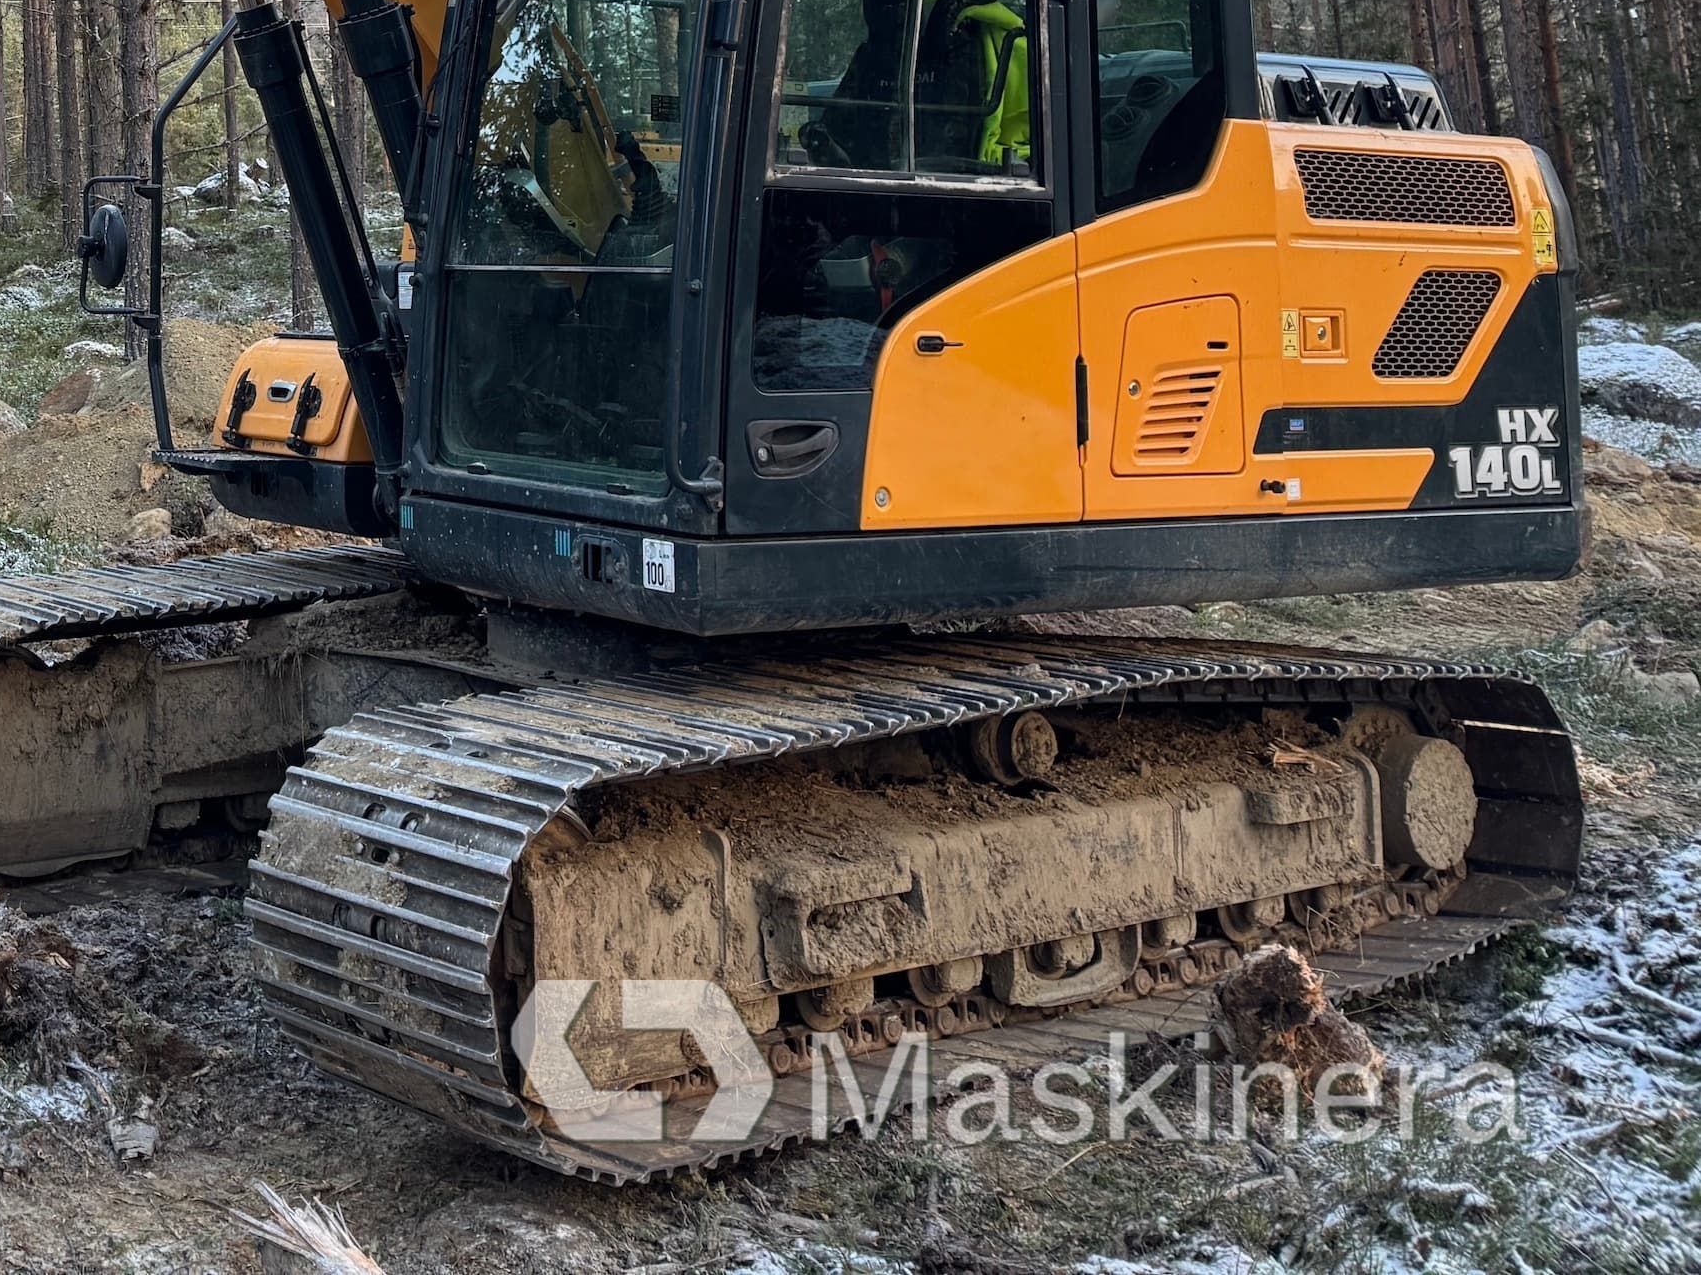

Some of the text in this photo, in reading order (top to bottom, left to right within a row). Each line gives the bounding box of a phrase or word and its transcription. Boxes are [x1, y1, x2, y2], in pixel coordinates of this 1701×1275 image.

[1497, 408, 1559, 444] HX
[1449, 445, 1562, 493] 140L
[646, 561, 664, 586] 100
